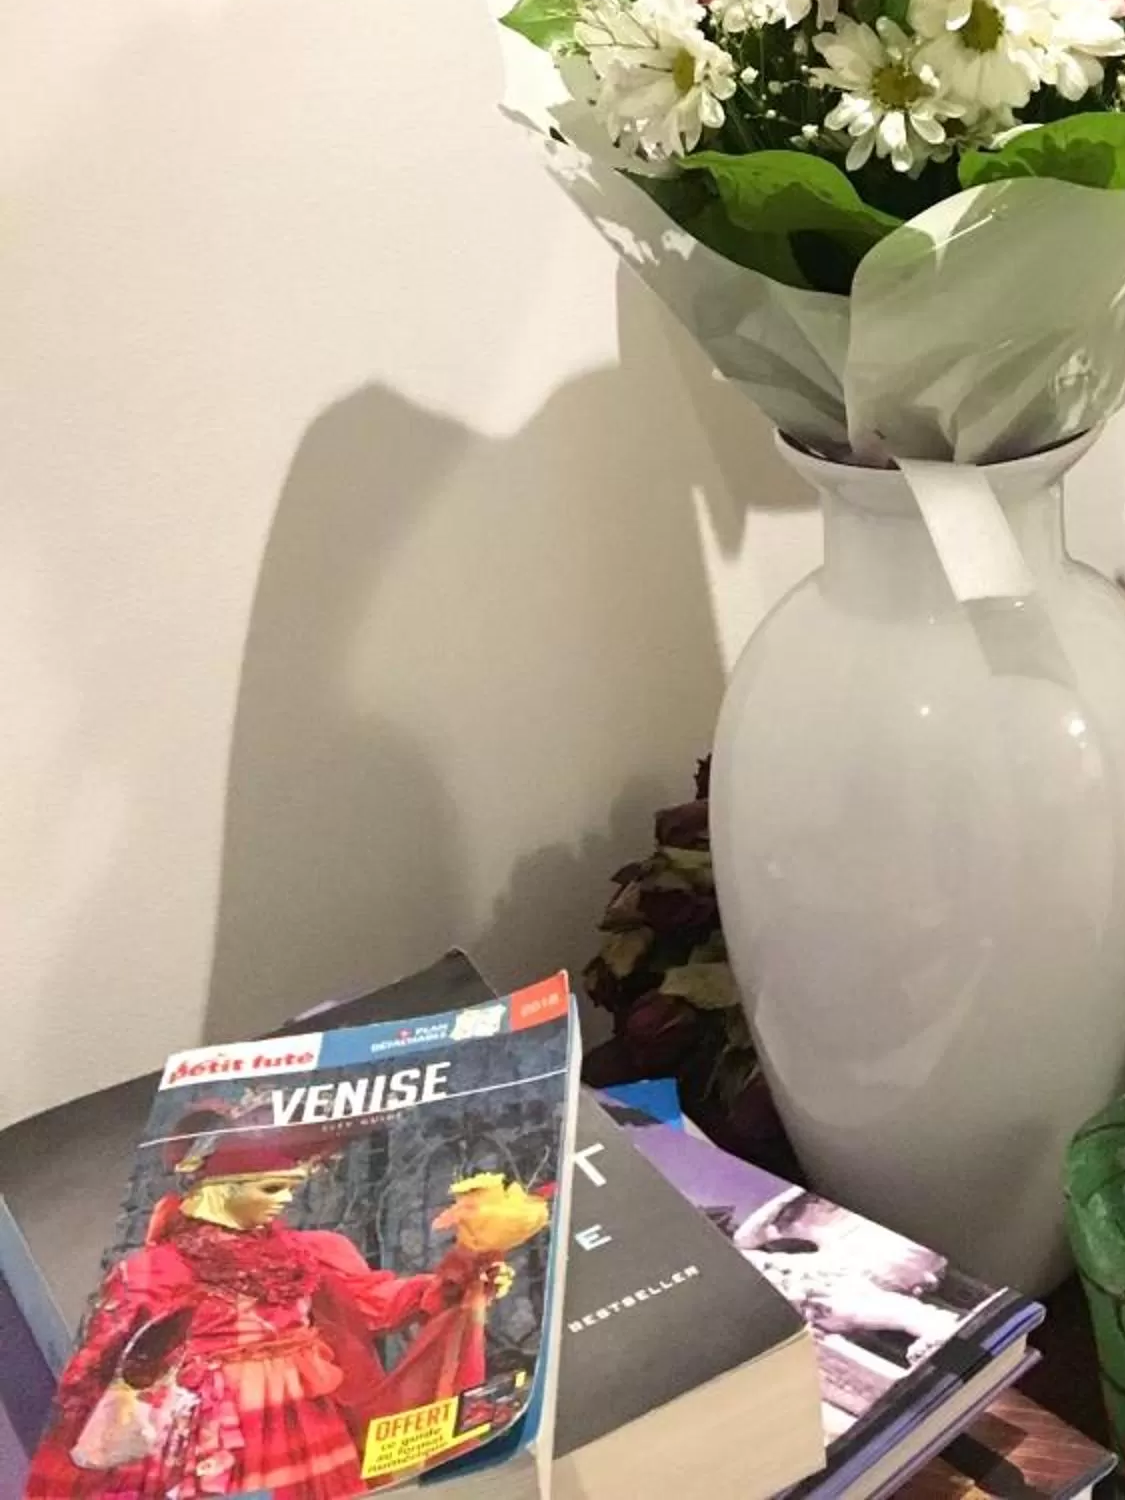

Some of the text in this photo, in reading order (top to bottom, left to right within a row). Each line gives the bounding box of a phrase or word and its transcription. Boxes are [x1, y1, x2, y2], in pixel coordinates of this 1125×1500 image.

[270, 1061, 451, 1127] VENISE
[567, 1265, 700, 1333] BESTSELLER
[375, 1403, 453, 1442] OFFERT
